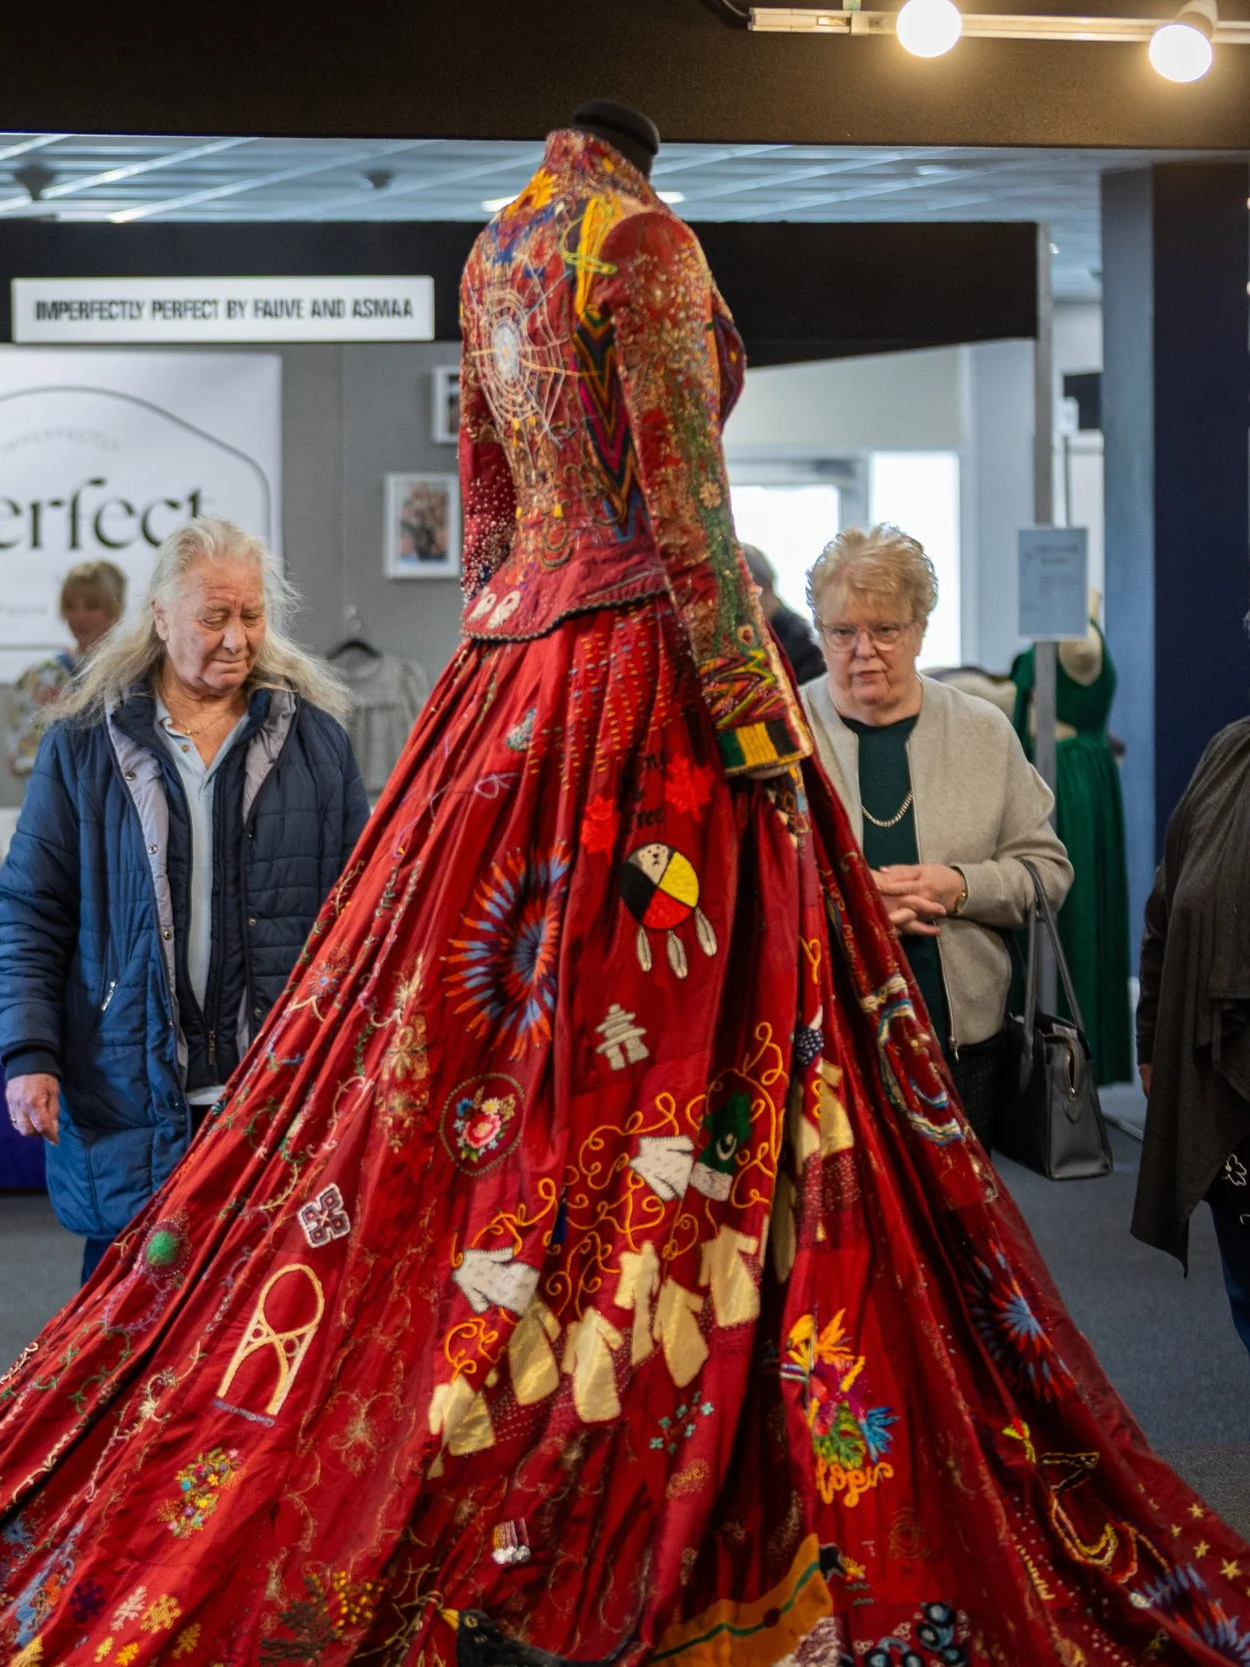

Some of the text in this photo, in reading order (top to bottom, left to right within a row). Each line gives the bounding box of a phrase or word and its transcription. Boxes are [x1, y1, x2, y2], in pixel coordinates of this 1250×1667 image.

[35, 298, 414, 322] IMPERFECTLY PERFECT BY FAUVE AND ASMAA
